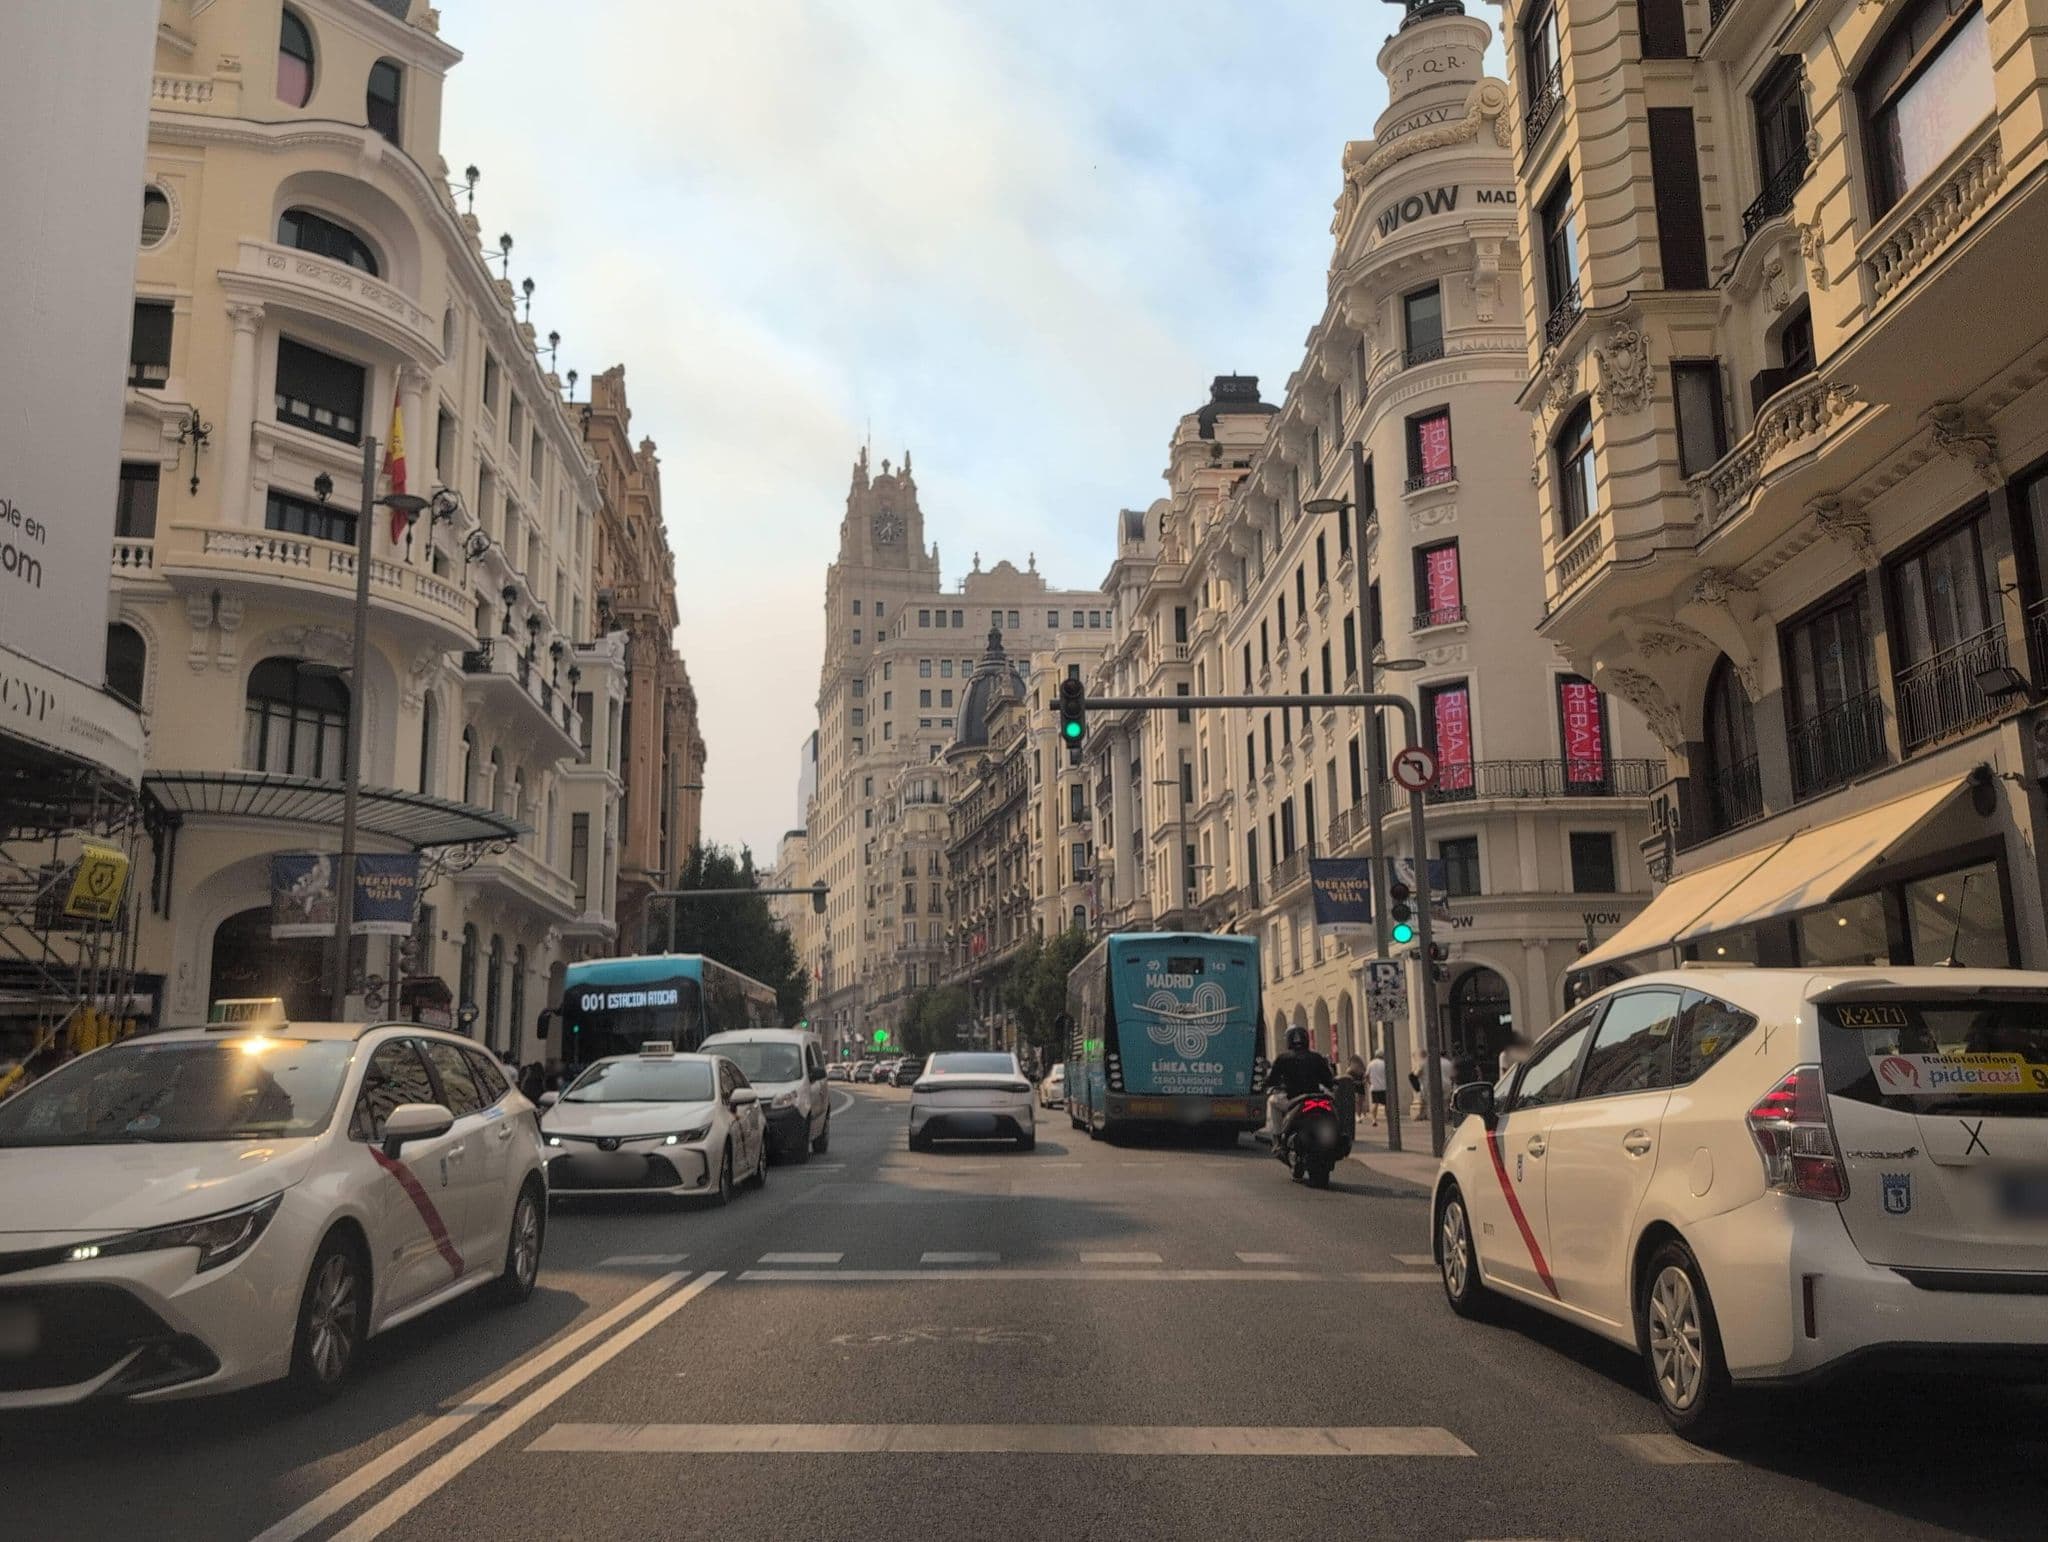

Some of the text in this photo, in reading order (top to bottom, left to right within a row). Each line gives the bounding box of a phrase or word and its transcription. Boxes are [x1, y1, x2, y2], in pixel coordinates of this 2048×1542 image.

[1377, 185, 1459, 238] WOW
[26, 517, 46, 545] en
[0, 544, 42, 588] om
[0, 672, 55, 721] CYP
[357, 874, 414, 887] VERANOS
[1314, 879, 1369, 890] VERANOS
[367, 888, 403, 900] VILLA
[1328, 891, 1363, 902] VILLA
[1451, 915, 1473, 928] OW
[1583, 912, 1620, 924] WOW
[1145, 973, 1194, 989] MADRID
[581, 993, 605, 1011] 001
[1152, 1058, 1223, 1073] LÍNEA CERO
[1152, 1075, 1176, 1085] CERO
[1929, 1066, 2021, 1088] pidetaxi
[1162, 1086, 1185, 1094] CERO
[1959, 1119, 1990, 1156] X
